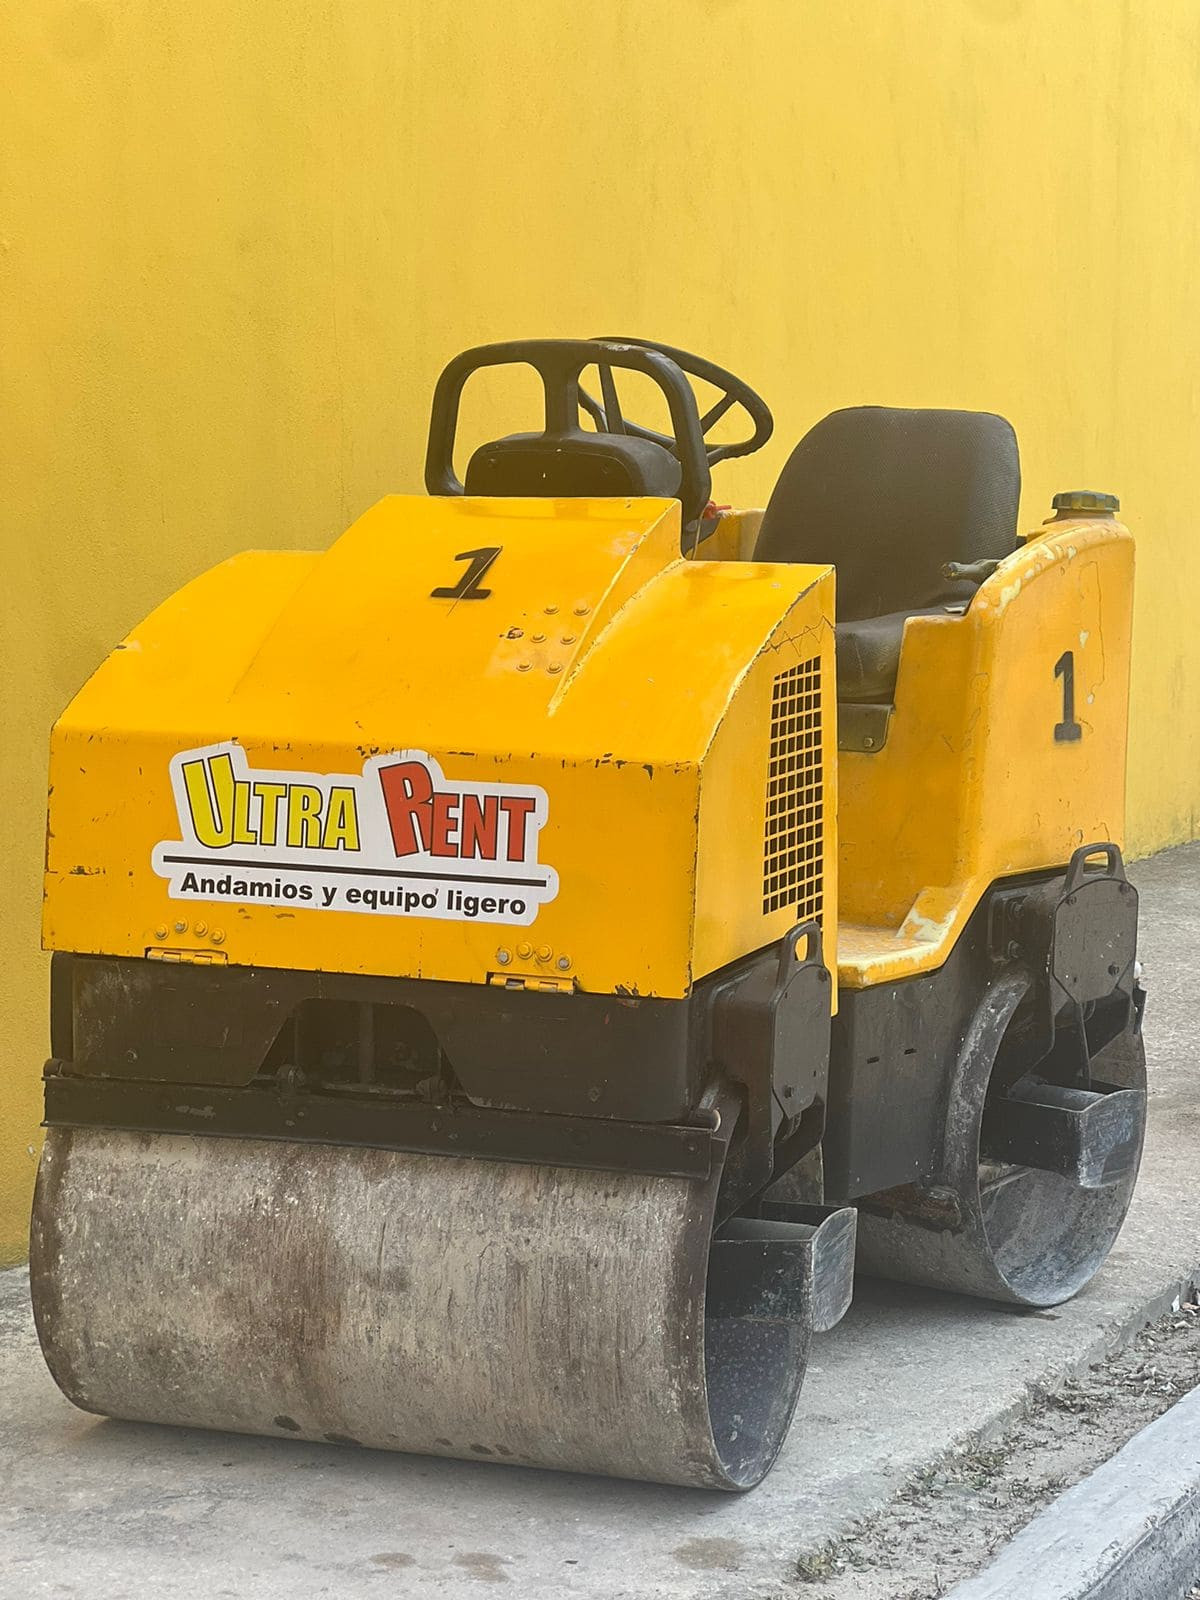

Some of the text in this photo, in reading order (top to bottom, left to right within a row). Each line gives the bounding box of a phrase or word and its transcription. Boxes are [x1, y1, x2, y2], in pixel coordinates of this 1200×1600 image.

[431, 547, 502, 599] 1
[1054, 651, 1082, 741] 1
[181, 752, 536, 863] ULTRA RENT
[180, 872, 527, 917] Andamios y equipo ligero
